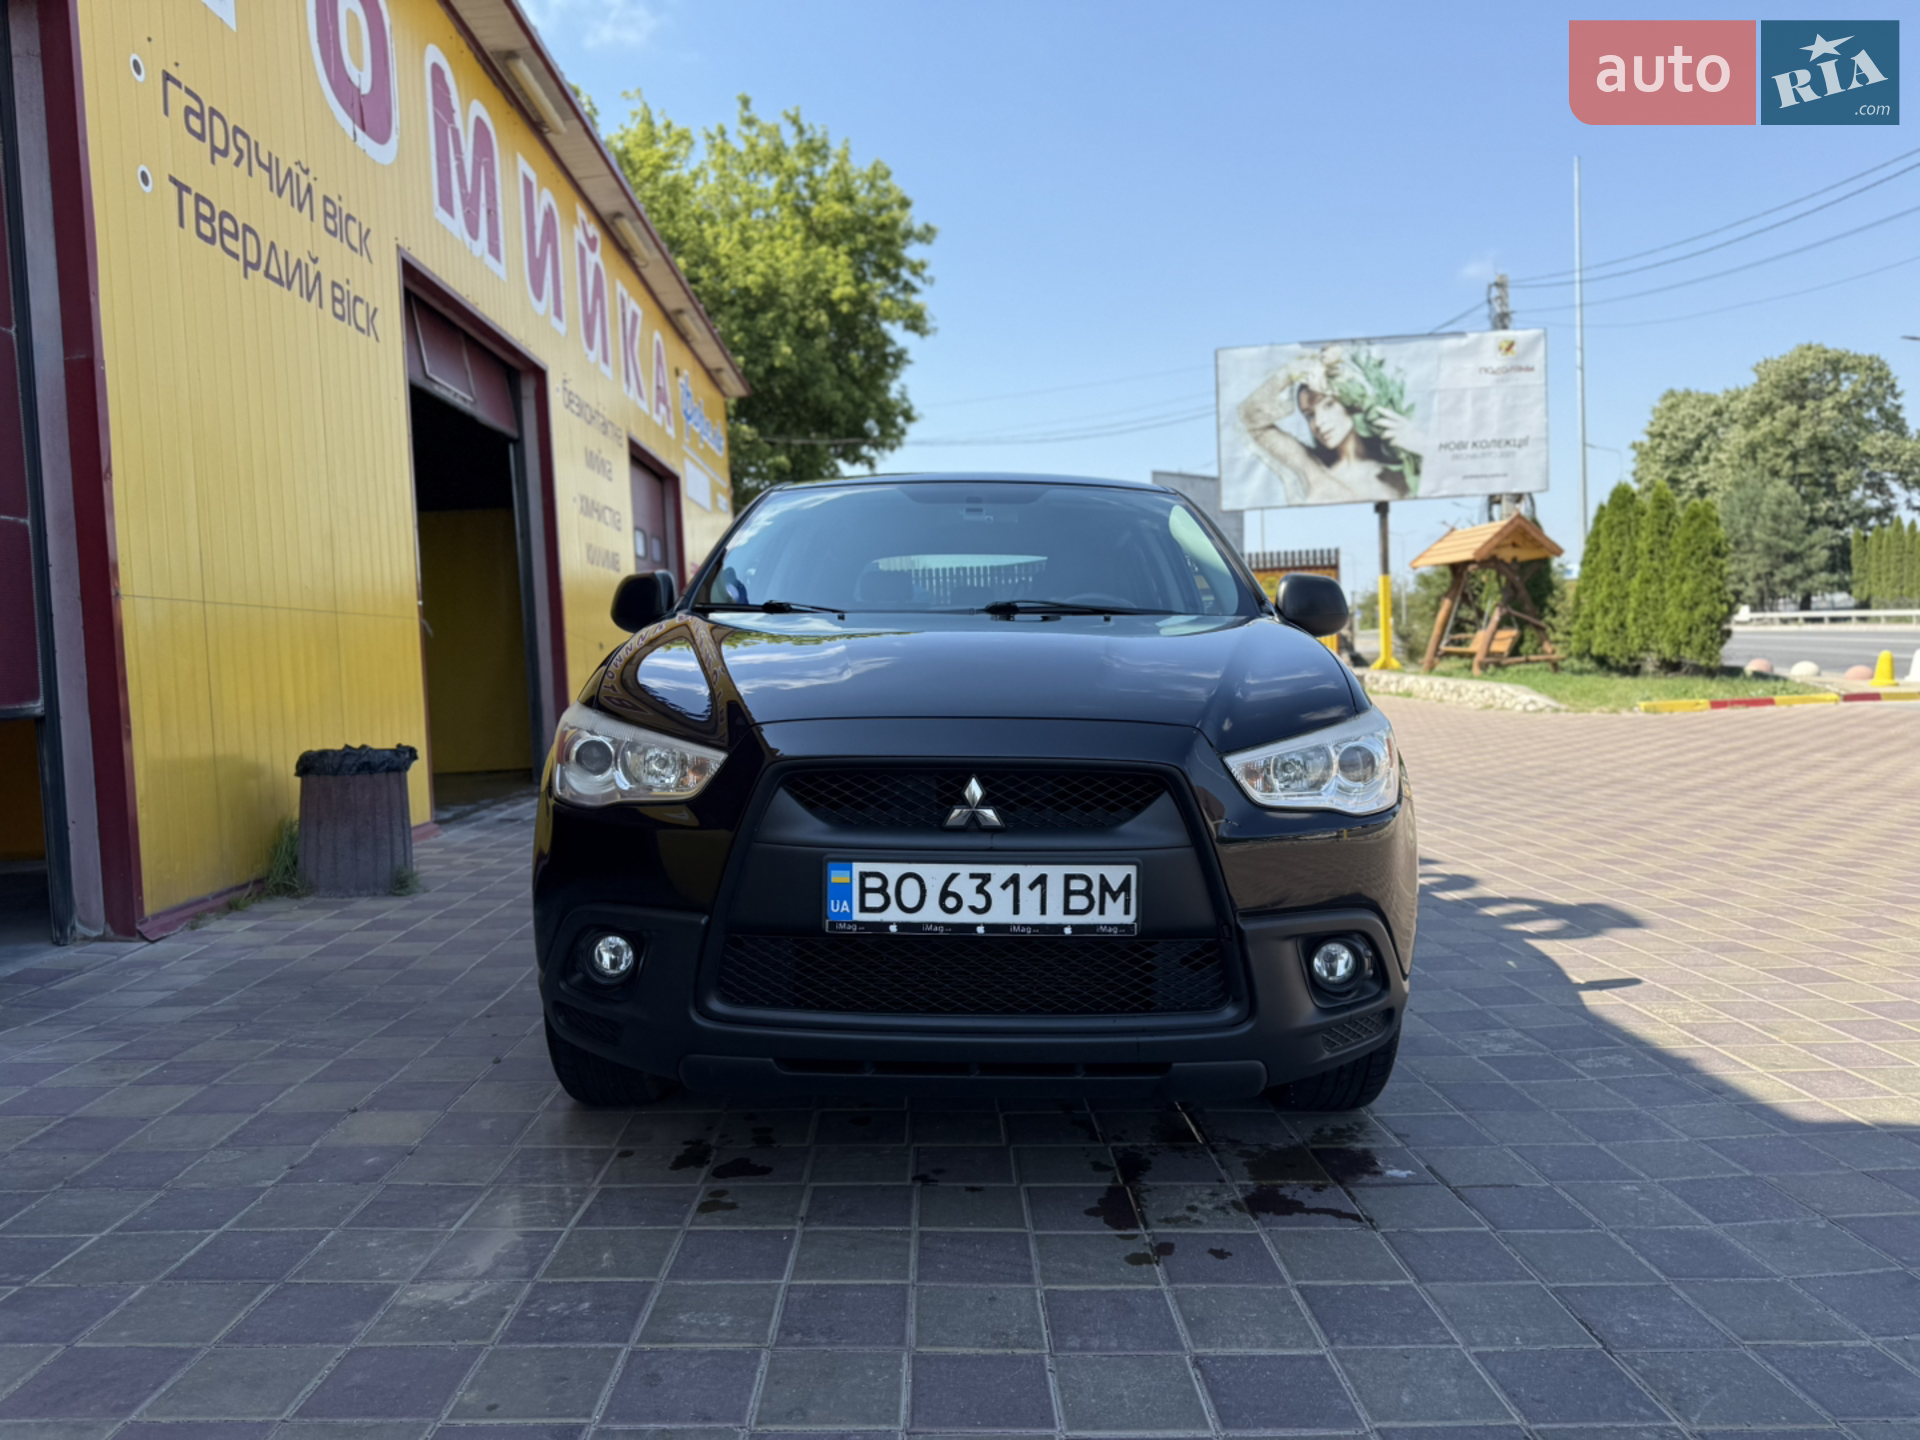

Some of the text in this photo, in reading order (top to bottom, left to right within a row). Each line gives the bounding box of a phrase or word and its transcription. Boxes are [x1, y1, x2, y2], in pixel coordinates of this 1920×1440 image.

[161, 68, 374, 265] гарячий віск
[168, 173, 381, 343] твердий віск
[830, 900, 850, 913] UA
[858, 870, 1132, 916] BO 6311 BM
